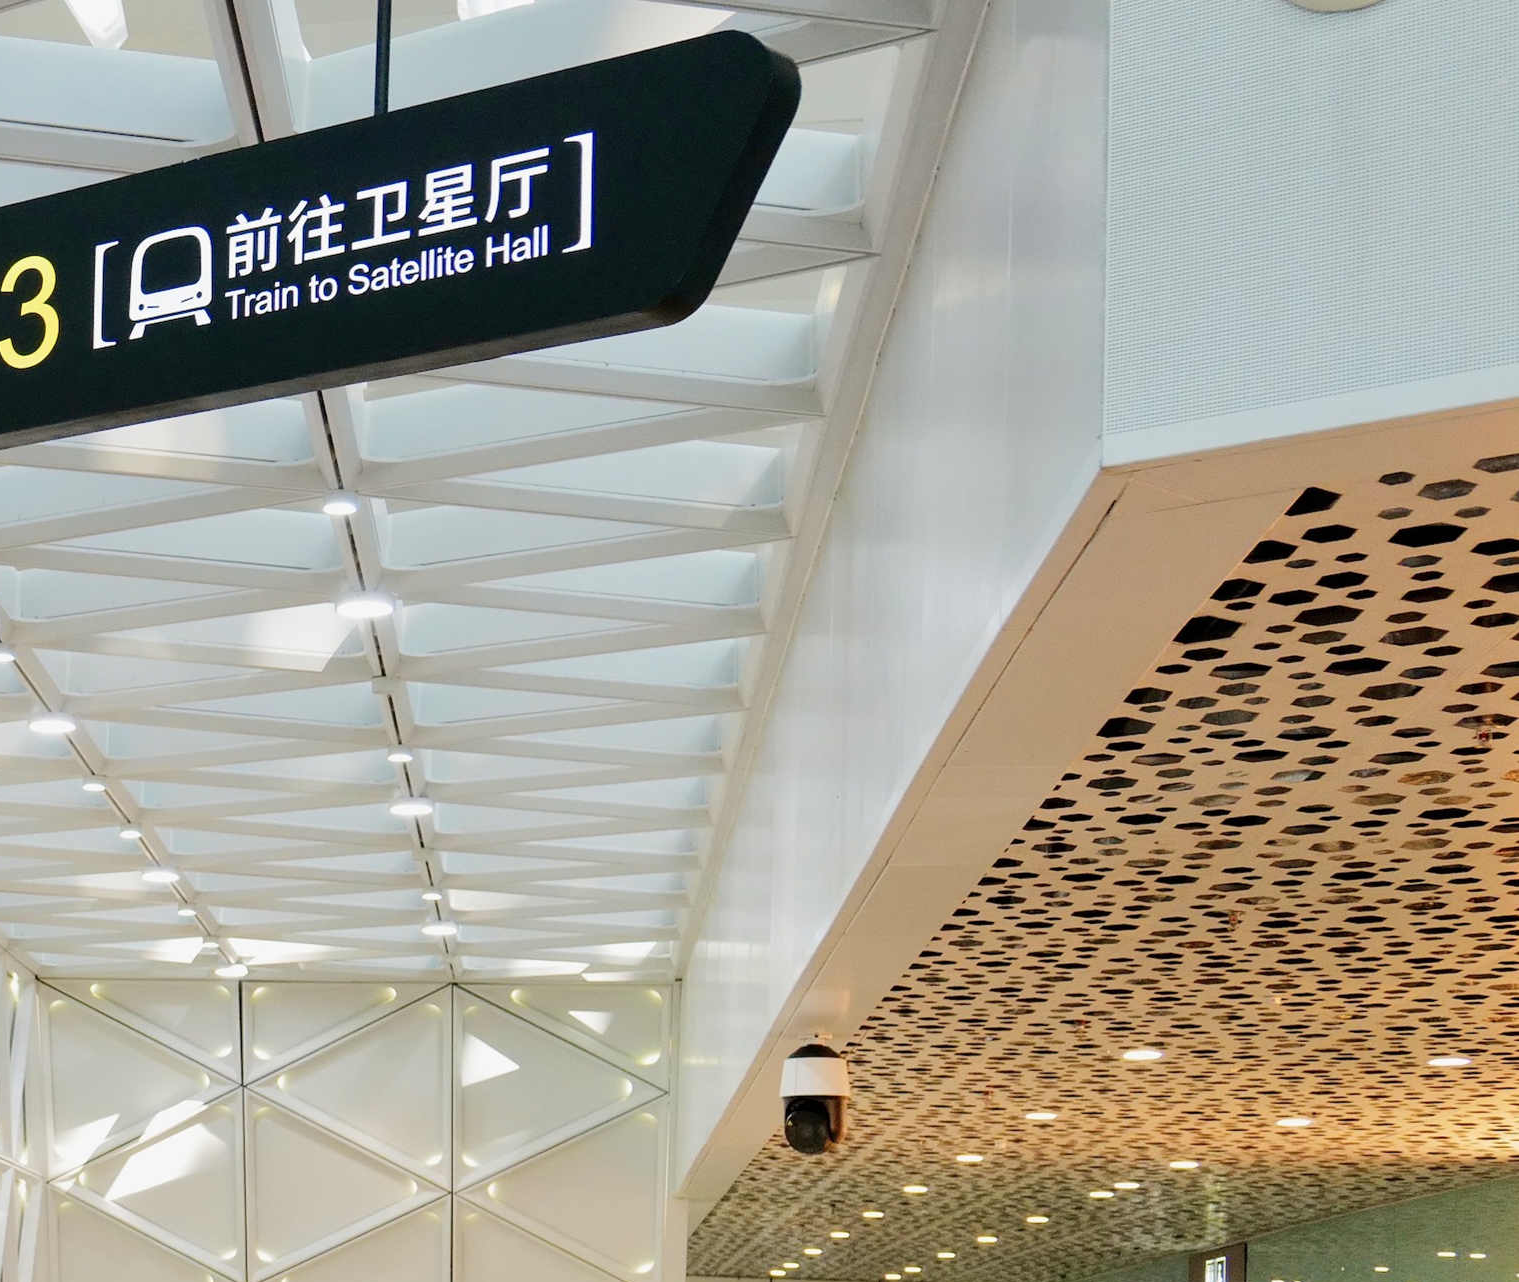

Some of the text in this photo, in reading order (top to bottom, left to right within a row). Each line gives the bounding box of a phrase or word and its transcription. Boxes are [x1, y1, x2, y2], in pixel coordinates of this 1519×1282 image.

[226, 147, 550, 279] 前往卫星厅
[225, 225, 549, 320] Train to Satellite Hall
